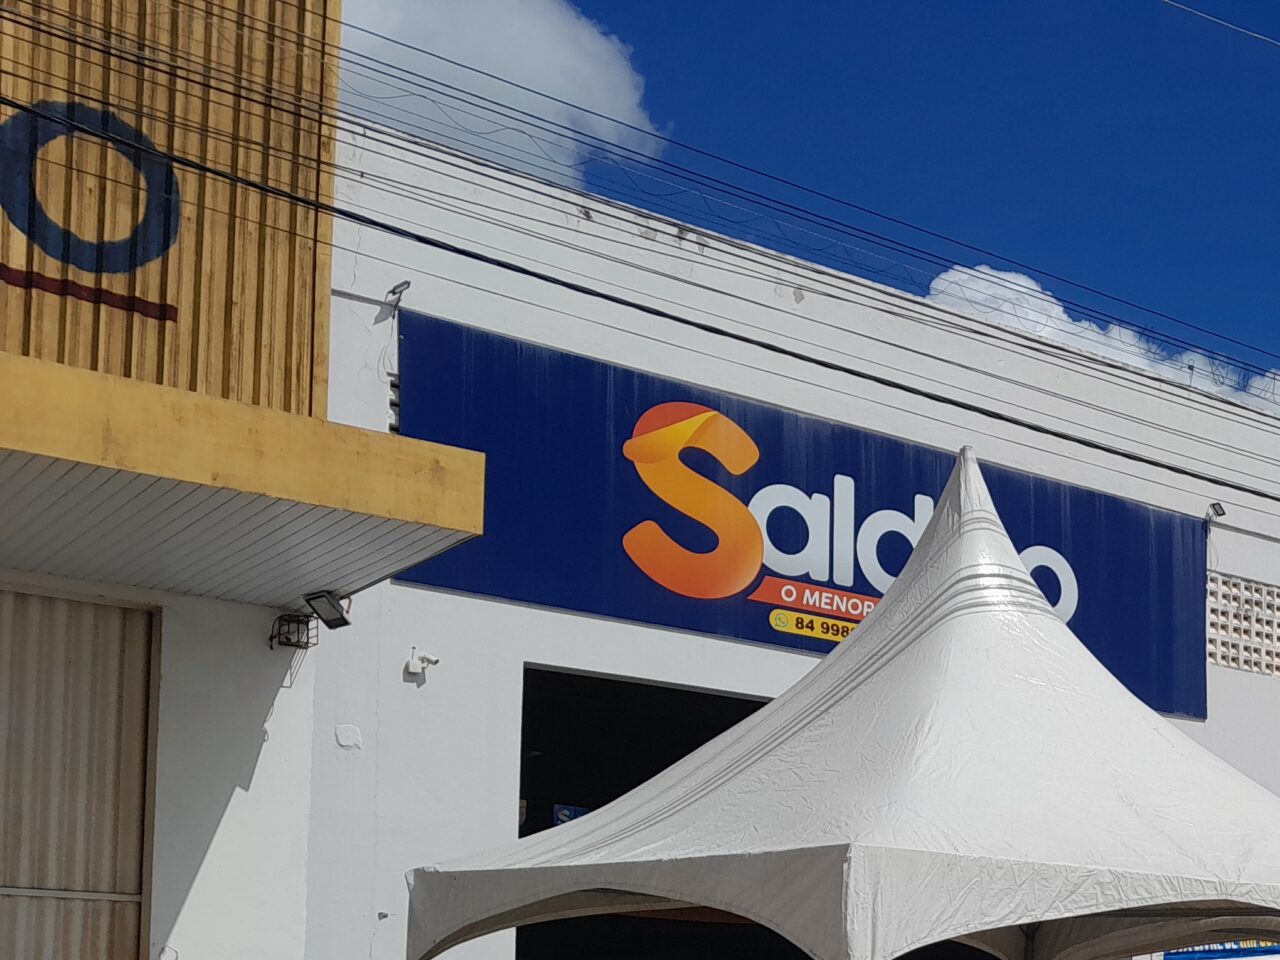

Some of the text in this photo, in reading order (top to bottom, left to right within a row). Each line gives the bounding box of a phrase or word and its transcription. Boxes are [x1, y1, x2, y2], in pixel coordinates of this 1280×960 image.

[622, 401, 1079, 626] Saldo
[781, 584, 797, 602] O
[795, 617, 856, 638] 84 998
